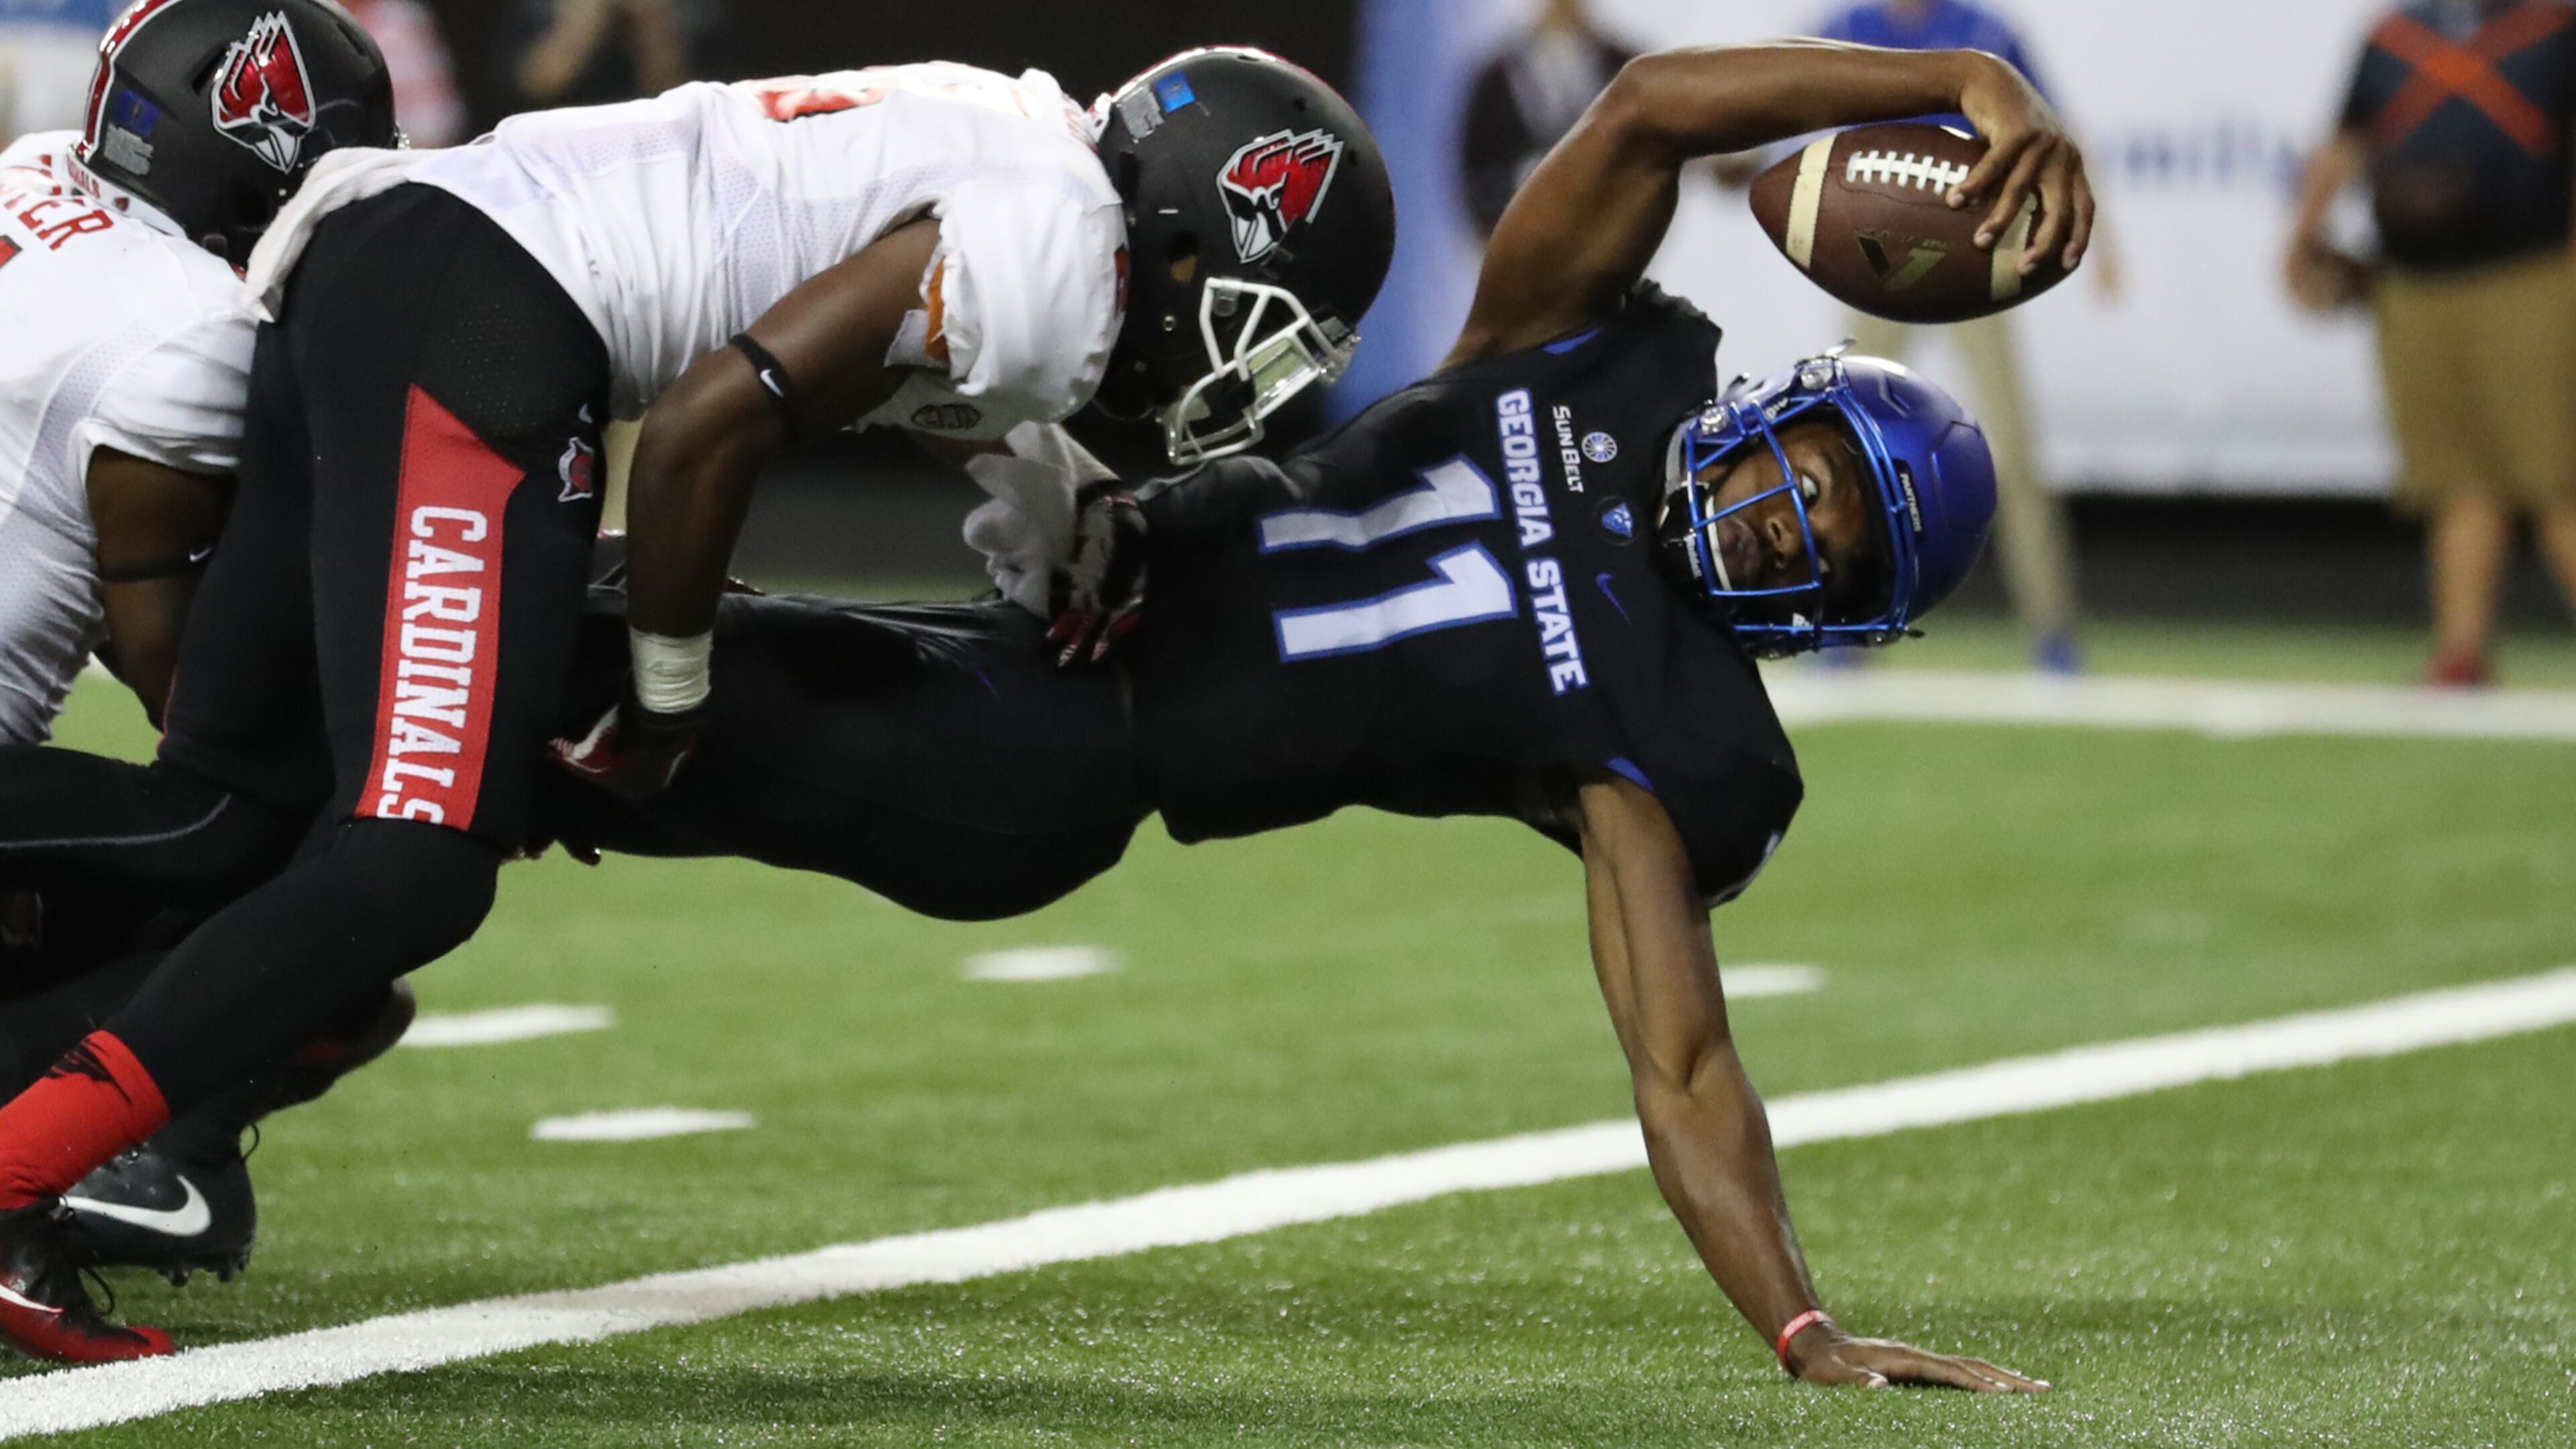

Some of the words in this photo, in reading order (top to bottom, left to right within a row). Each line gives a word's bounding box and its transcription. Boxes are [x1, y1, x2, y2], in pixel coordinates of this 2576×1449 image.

[1552, 405, 1574, 447] SUN
[1560, 447, 1585, 493] BELT
[1256, 451, 1519, 664] 11
[1496, 388, 1554, 548] GEORGIA
[1526, 559, 1588, 693] STATE
[376, 504, 488, 825] CARDINALS
